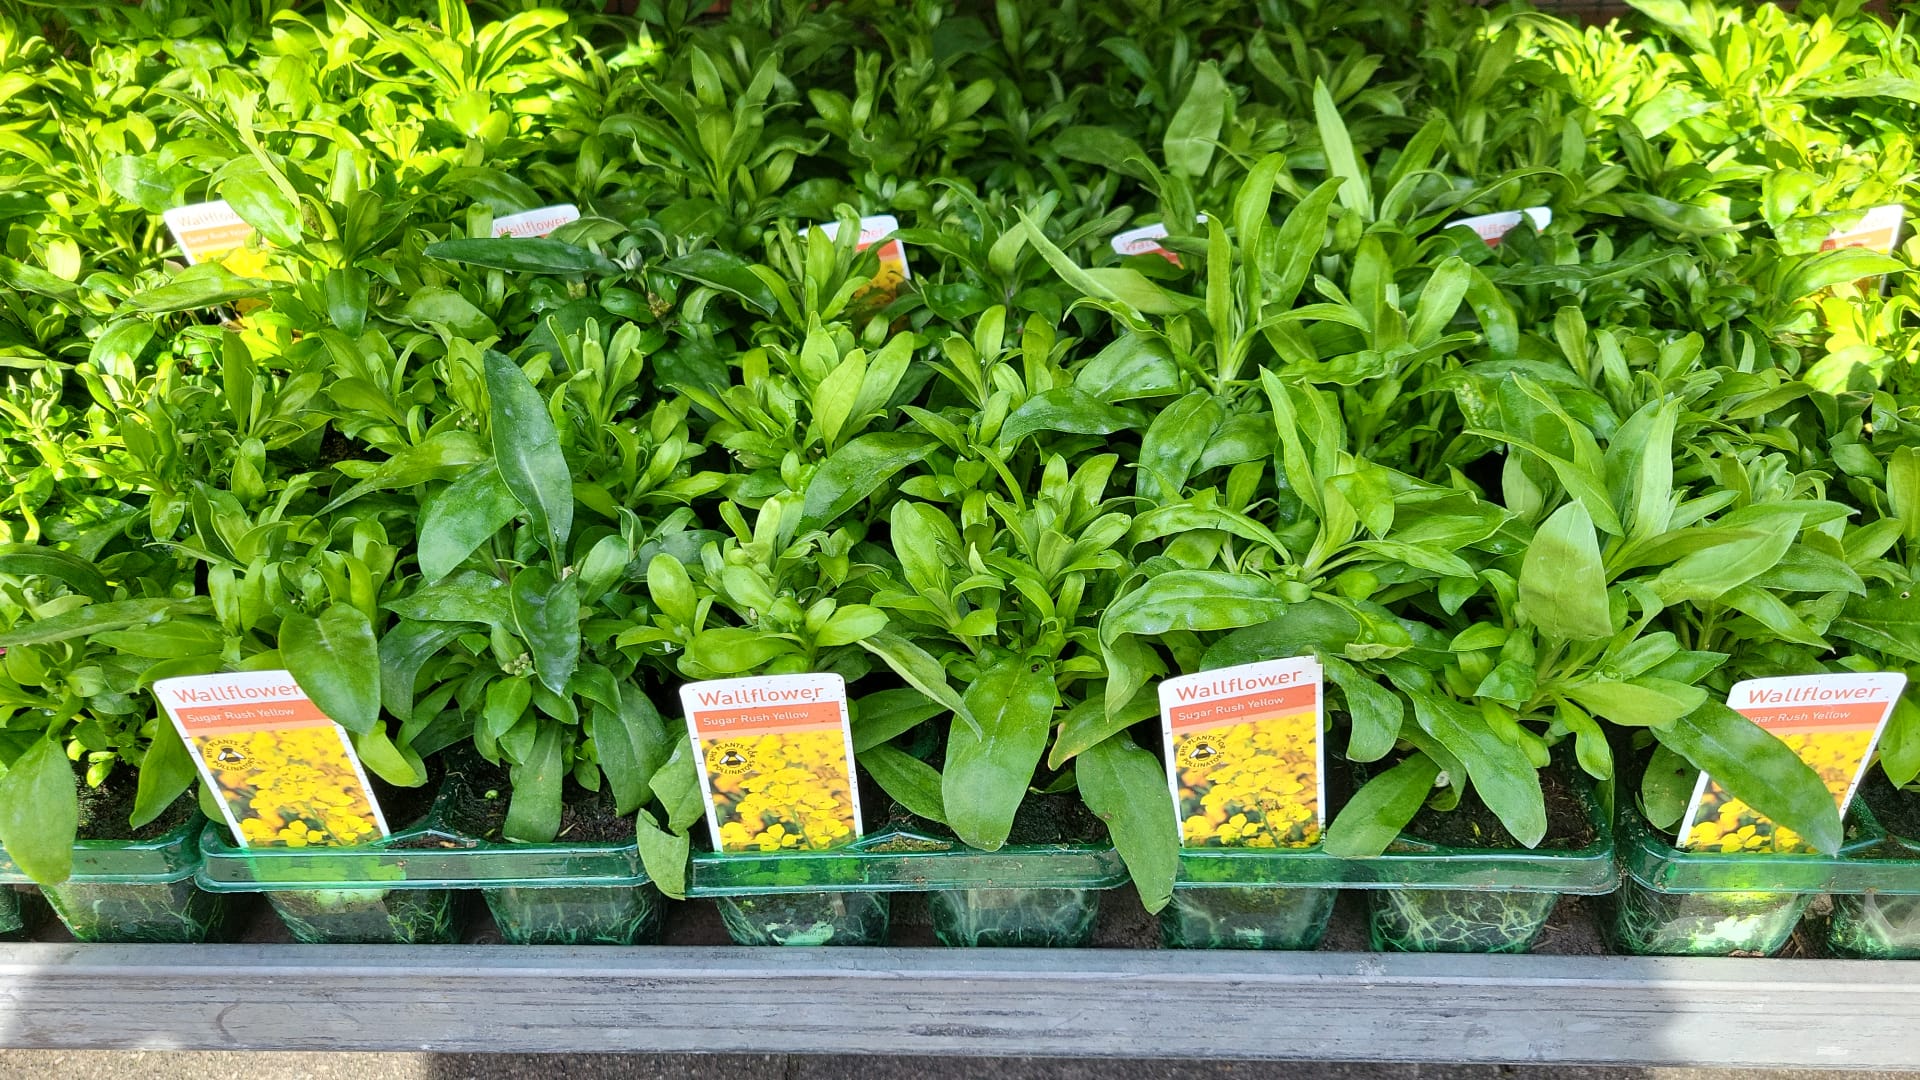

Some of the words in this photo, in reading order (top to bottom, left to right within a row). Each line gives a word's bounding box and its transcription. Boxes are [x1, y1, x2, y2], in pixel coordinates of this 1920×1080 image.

[496, 216, 568, 236] Wallflower
[173, 684, 299, 704] Wallflower
[1176, 670, 1302, 702] Wallflower
[1750, 686, 1882, 704] Wallflower
[698, 687, 824, 706] Wallflower
[187, 713, 222, 724] Sugar
[225, 708, 255, 720] Rush
[257, 707, 295, 718] Yellow
[703, 715, 737, 727] Sugar
[741, 713, 770, 723] Rush
[772, 710, 809, 721] Yellow
[1178, 708, 1212, 721] Sugar
[1215, 703, 1245, 715] Rush
[1247, 697, 1285, 708] Yellow
[1777, 713, 1808, 722] Rush
[1812, 710, 1852, 720] Yellow
